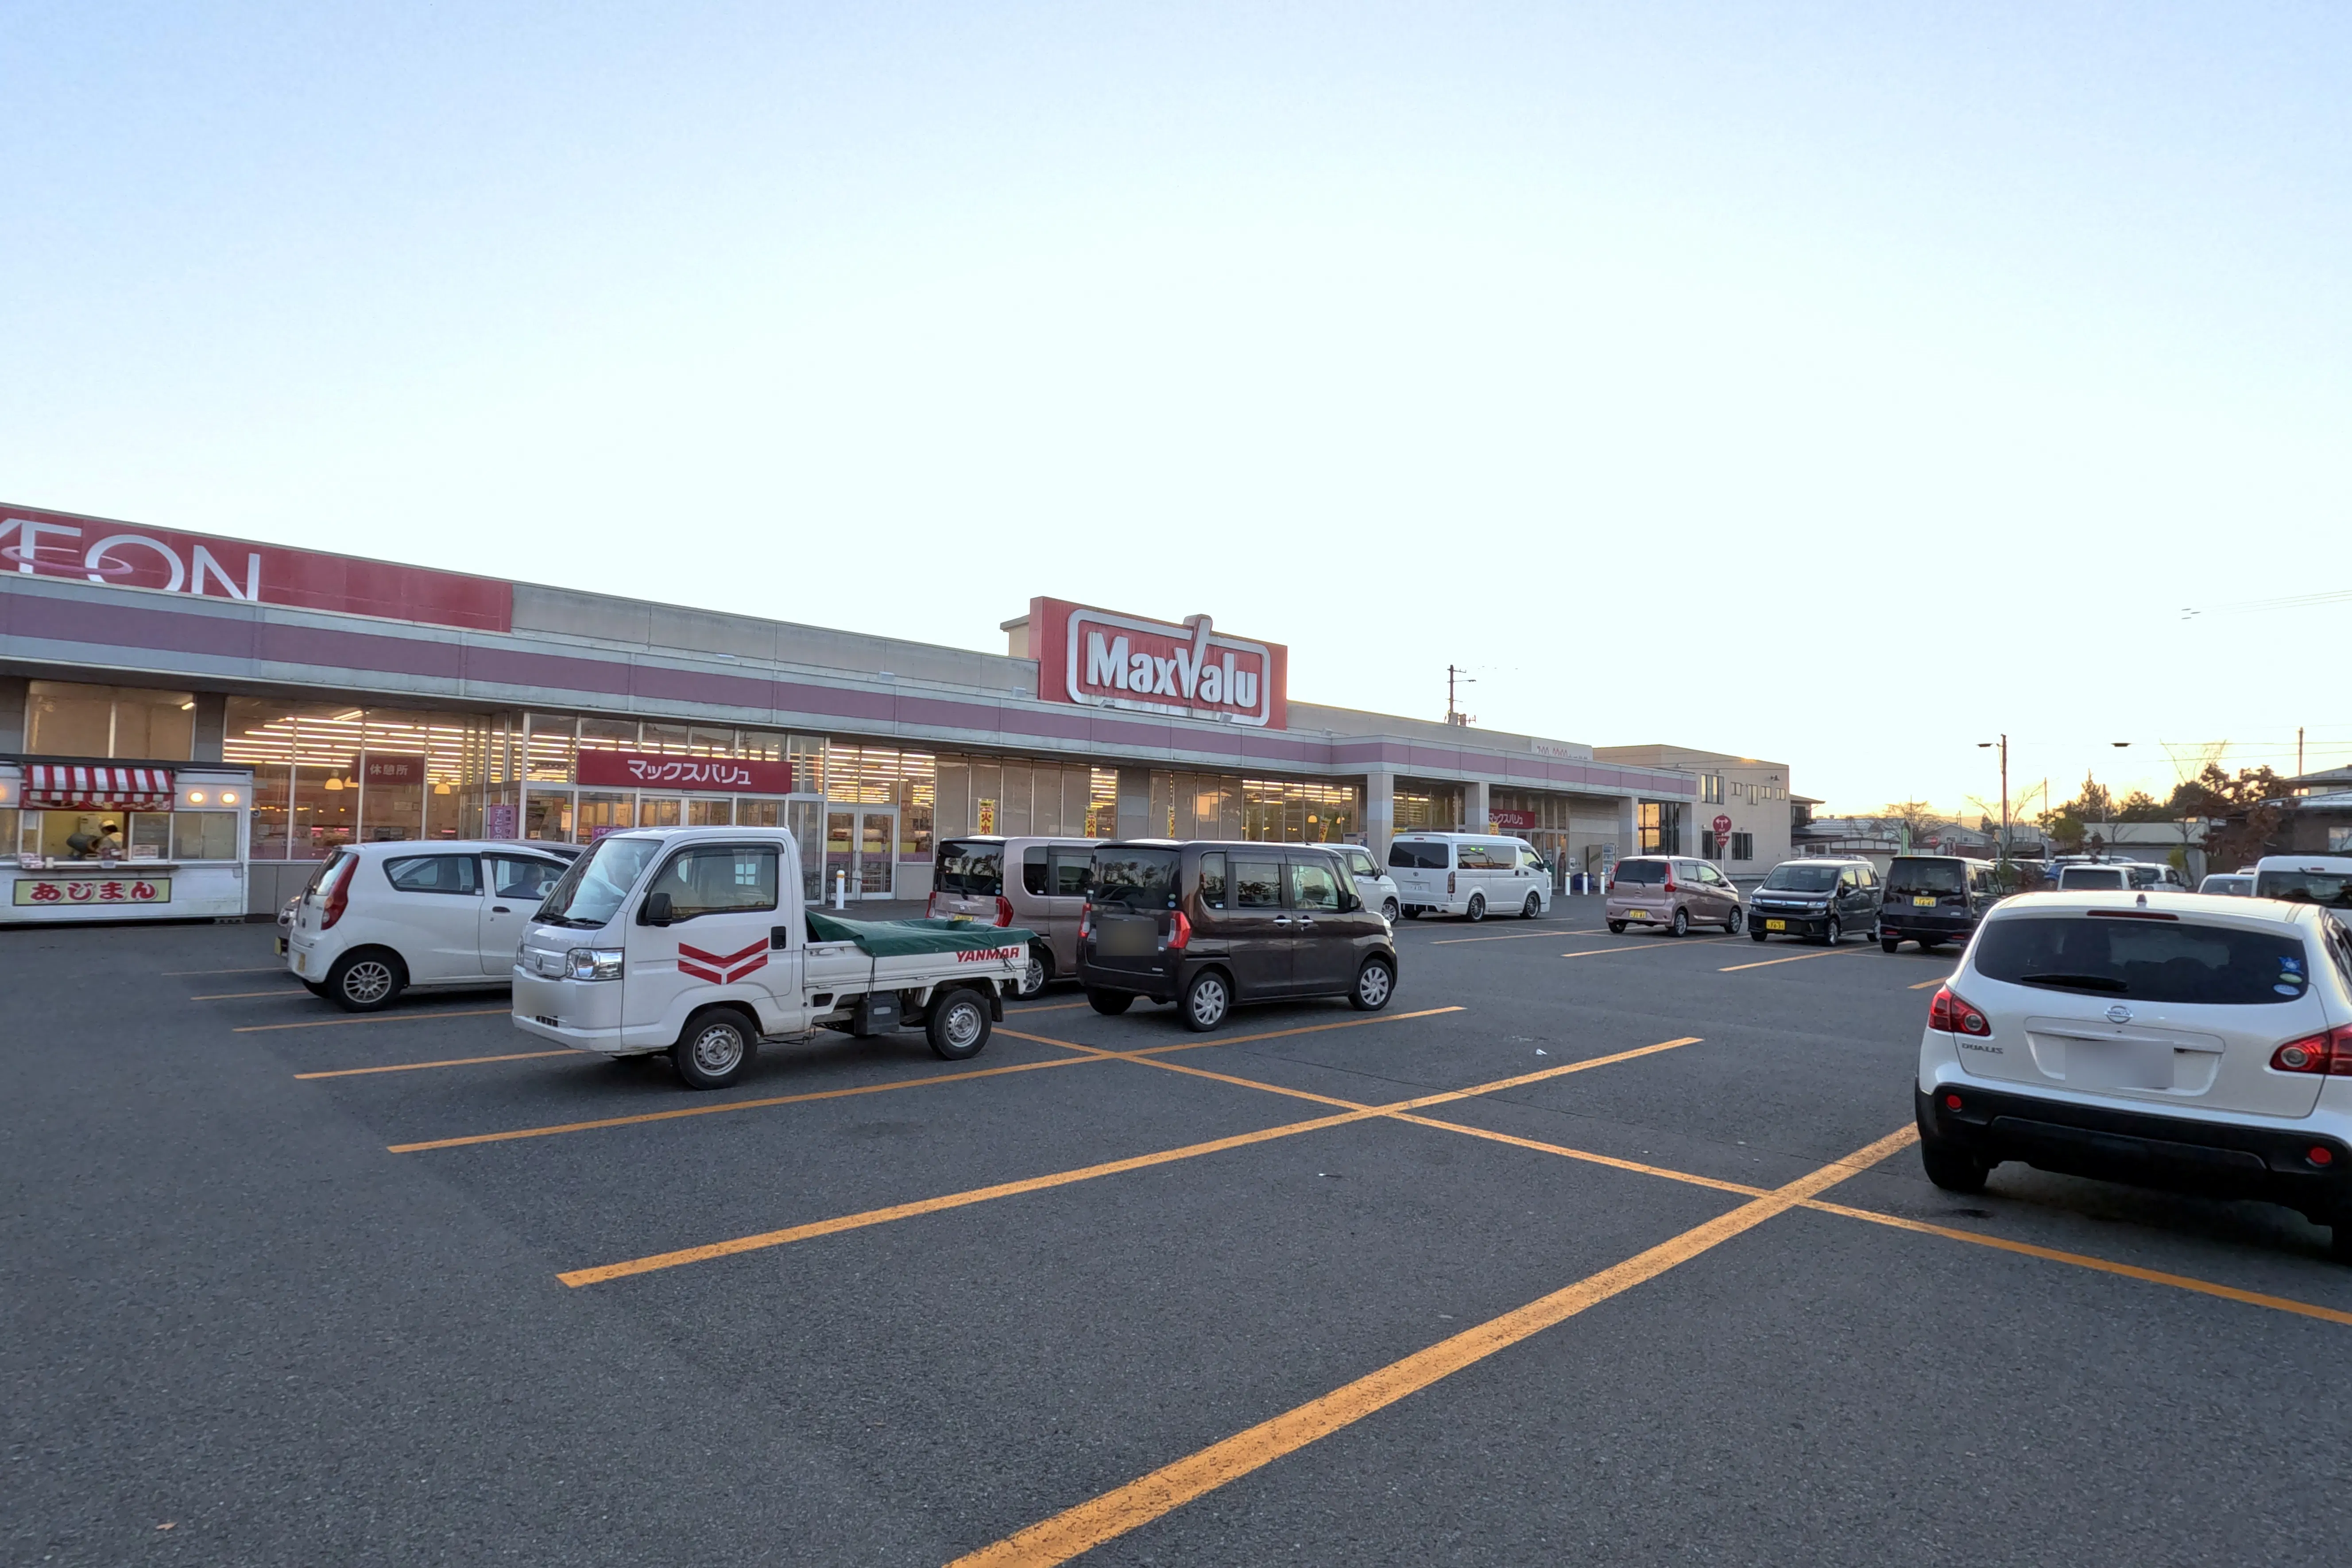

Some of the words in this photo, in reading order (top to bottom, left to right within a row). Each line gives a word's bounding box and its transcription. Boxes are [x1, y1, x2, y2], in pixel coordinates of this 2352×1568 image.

[1086, 617, 1257, 708] MaxValu
[370, 764, 408, 776] 休憩所
[627, 760, 752, 785] マックスバリュ
[1489, 813, 1523, 825] マックスバリュ
[30, 881, 157, 901] あじまん
[956, 947, 1020, 962] YANMAR
[1962, 1043, 2003, 1054] DUALIS
